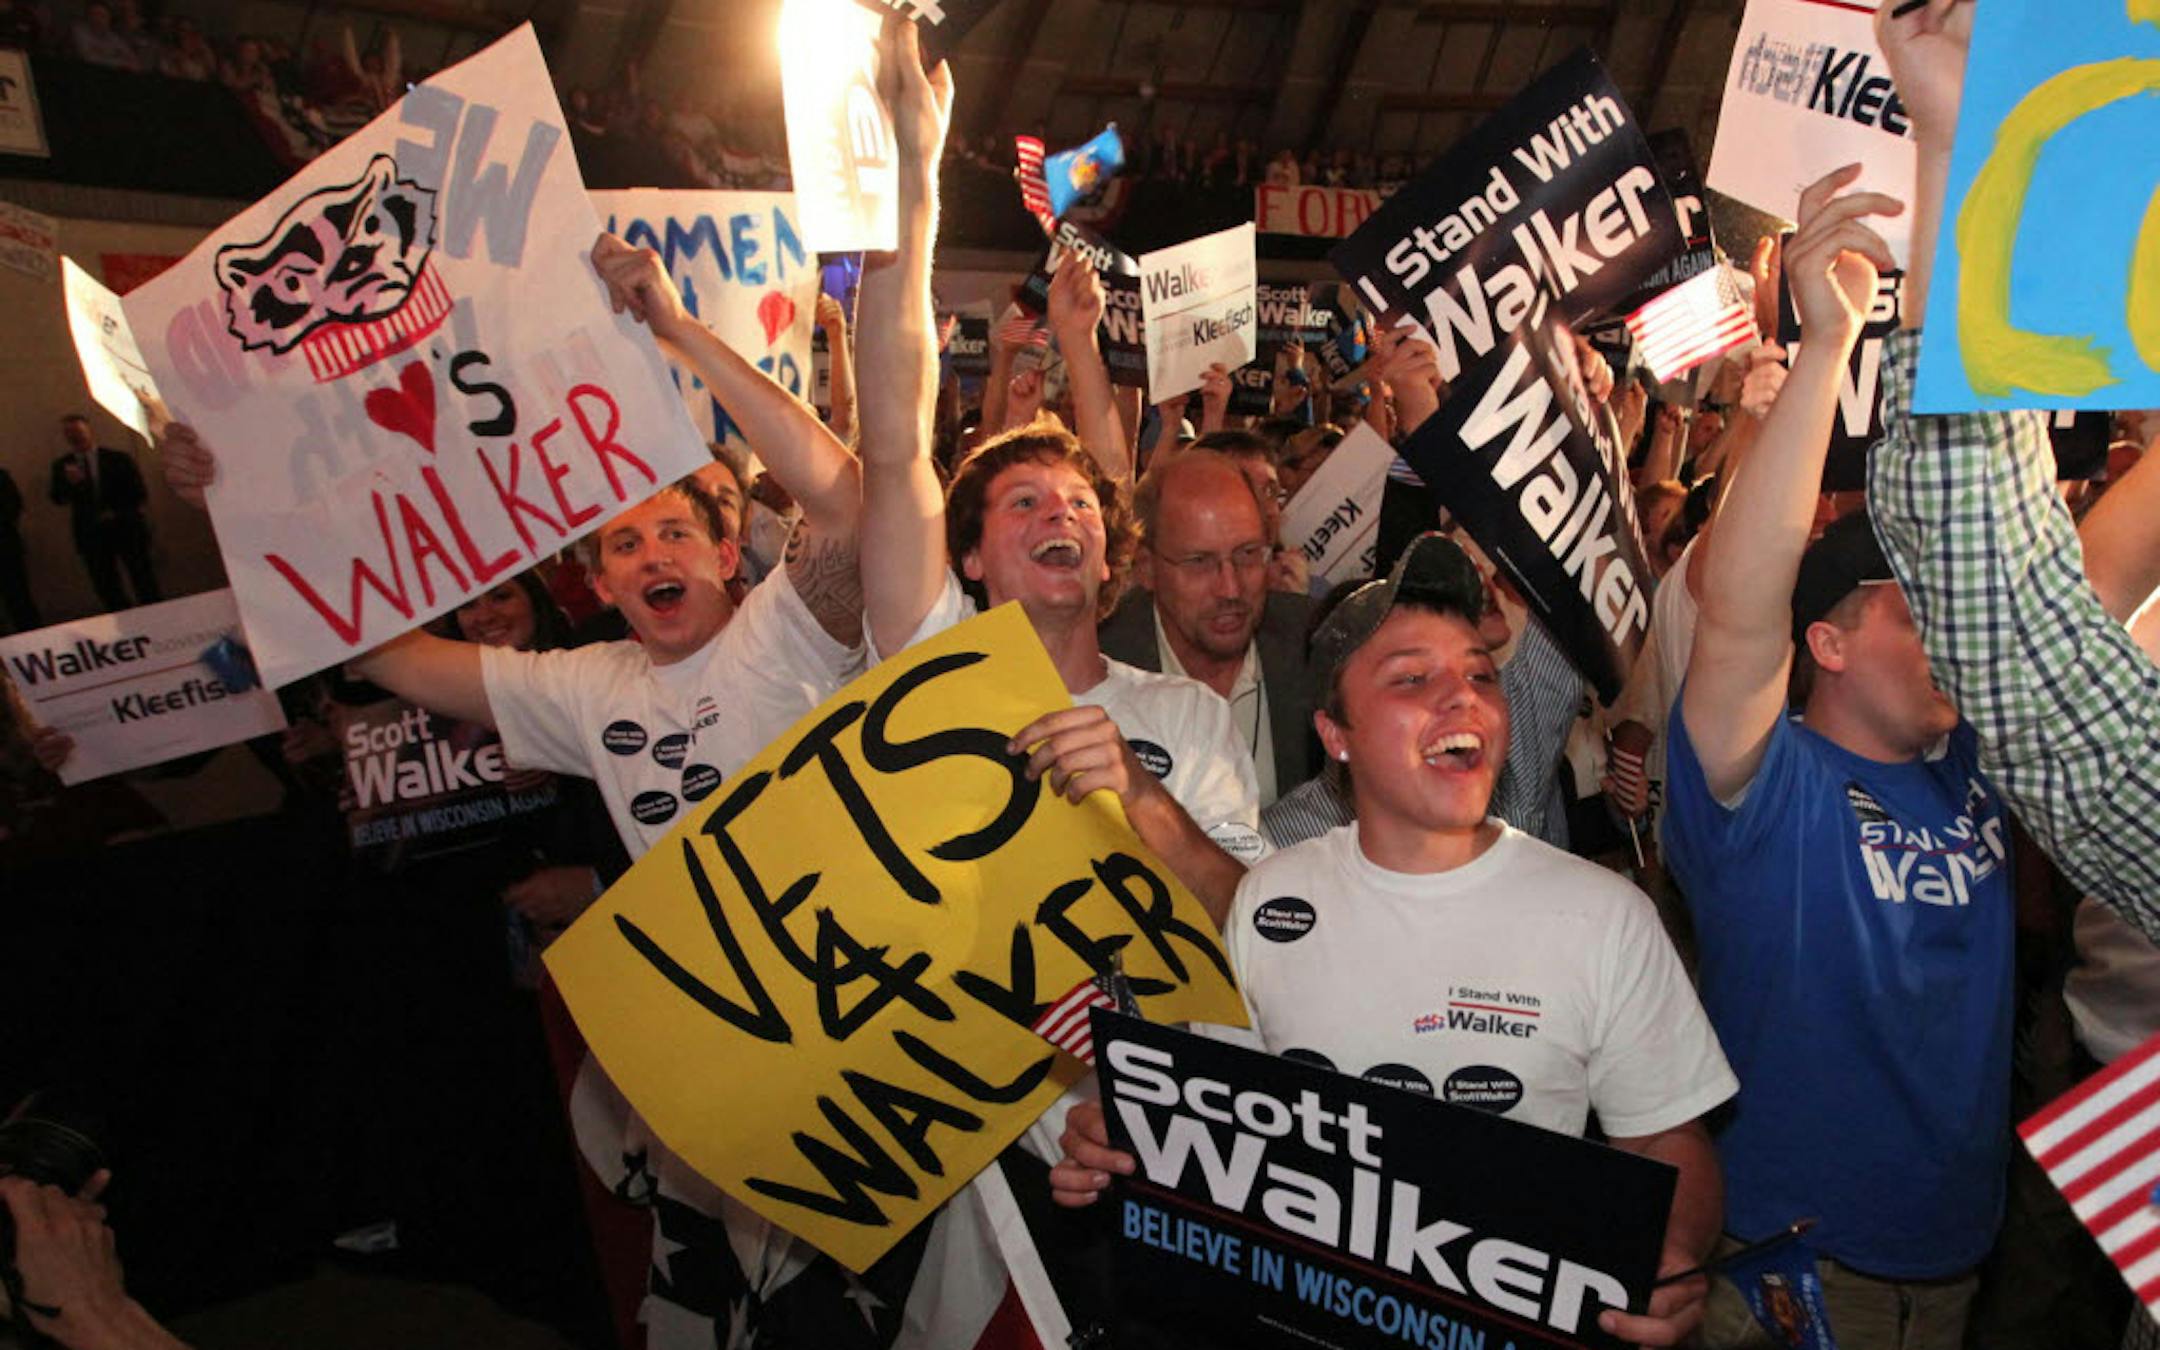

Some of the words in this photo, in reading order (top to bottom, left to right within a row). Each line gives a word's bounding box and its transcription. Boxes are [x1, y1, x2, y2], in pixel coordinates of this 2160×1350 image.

[1256, 185, 1373, 236] FOR
[1358, 275, 1389, 313] I
[1385, 166, 1521, 289] Stand
[1514, 93, 1626, 184] With
[605, 205, 806, 285] OMEN
[1394, 165, 1656, 383] Walker
[1193, 303, 1252, 347] Kleefisch
[1257, 284, 1307, 303] Scott
[1258, 300, 1333, 328] Walker
[264, 383, 658, 647] WALKER
[1458, 340, 1648, 648] Walker
[12, 635, 151, 686] Walker
[112, 677, 262, 724] Kleefis
[347, 707, 434, 758] Scott
[420, 797, 506, 834] WISCONSIN
[614, 651, 1042, 1044] VETS
[811, 908, 956, 1042] 4
[1458, 986, 1501, 1002] Stand
[1506, 992, 1541, 1008] With
[745, 852, 1237, 1227] WALKER
[1447, 1009, 1539, 1039] Walker
[1106, 1038, 1384, 1169] Scott
[1456, 1080, 1488, 1090] Stand
[1112, 1097, 1630, 1336] Walker
[1122, 1199, 1243, 1276] BELIEVE
[1251, 1245, 1285, 1293] IN
[1294, 1261, 1486, 1350] WISCONSIN
